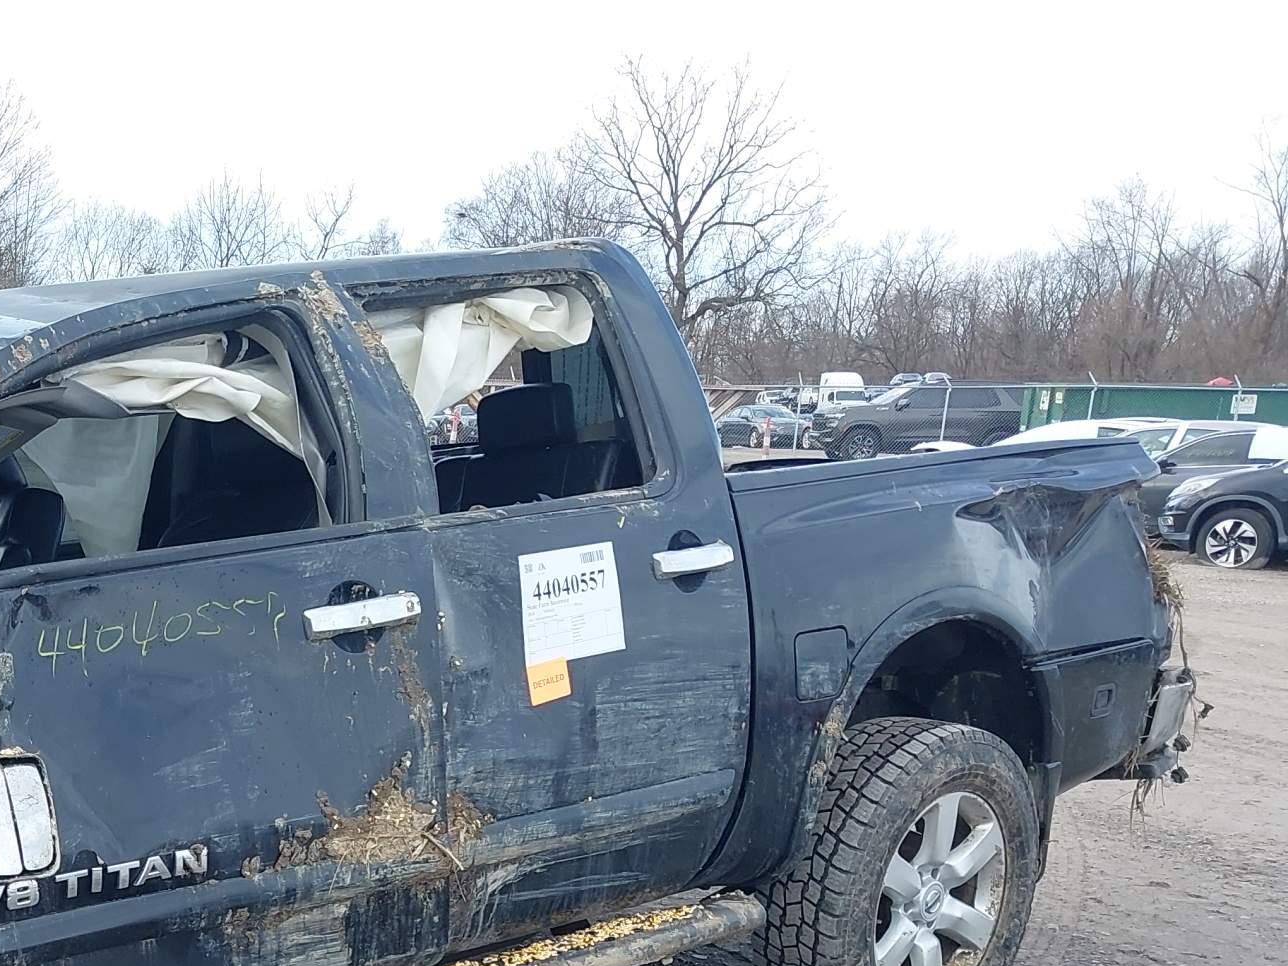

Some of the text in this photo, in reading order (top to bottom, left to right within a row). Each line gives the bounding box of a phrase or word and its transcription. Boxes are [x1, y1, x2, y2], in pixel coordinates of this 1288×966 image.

[532, 569, 605, 601] 44040557
[532, 673, 565, 690] DETAILED
[55, 845, 209, 899] TITAN
